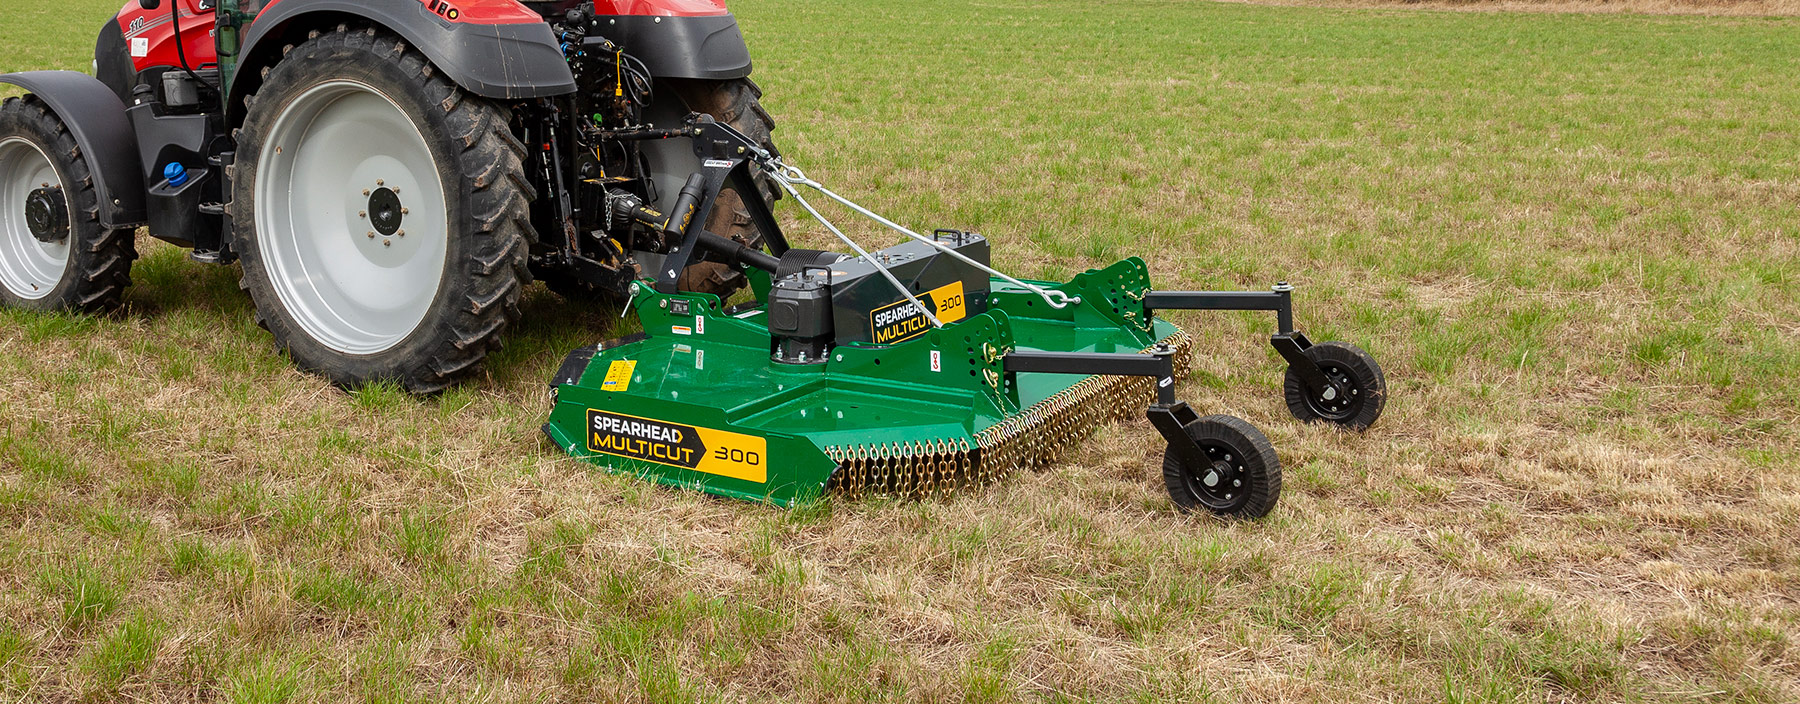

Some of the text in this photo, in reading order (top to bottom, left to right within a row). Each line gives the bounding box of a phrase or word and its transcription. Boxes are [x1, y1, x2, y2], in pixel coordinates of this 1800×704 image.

[129, 16, 144, 33] 110
[940, 294, 962, 312] 300
[593, 415, 684, 444] SPEARHEAD
[593, 432, 694, 463] MULTICUT
[714, 446, 759, 466] 300
